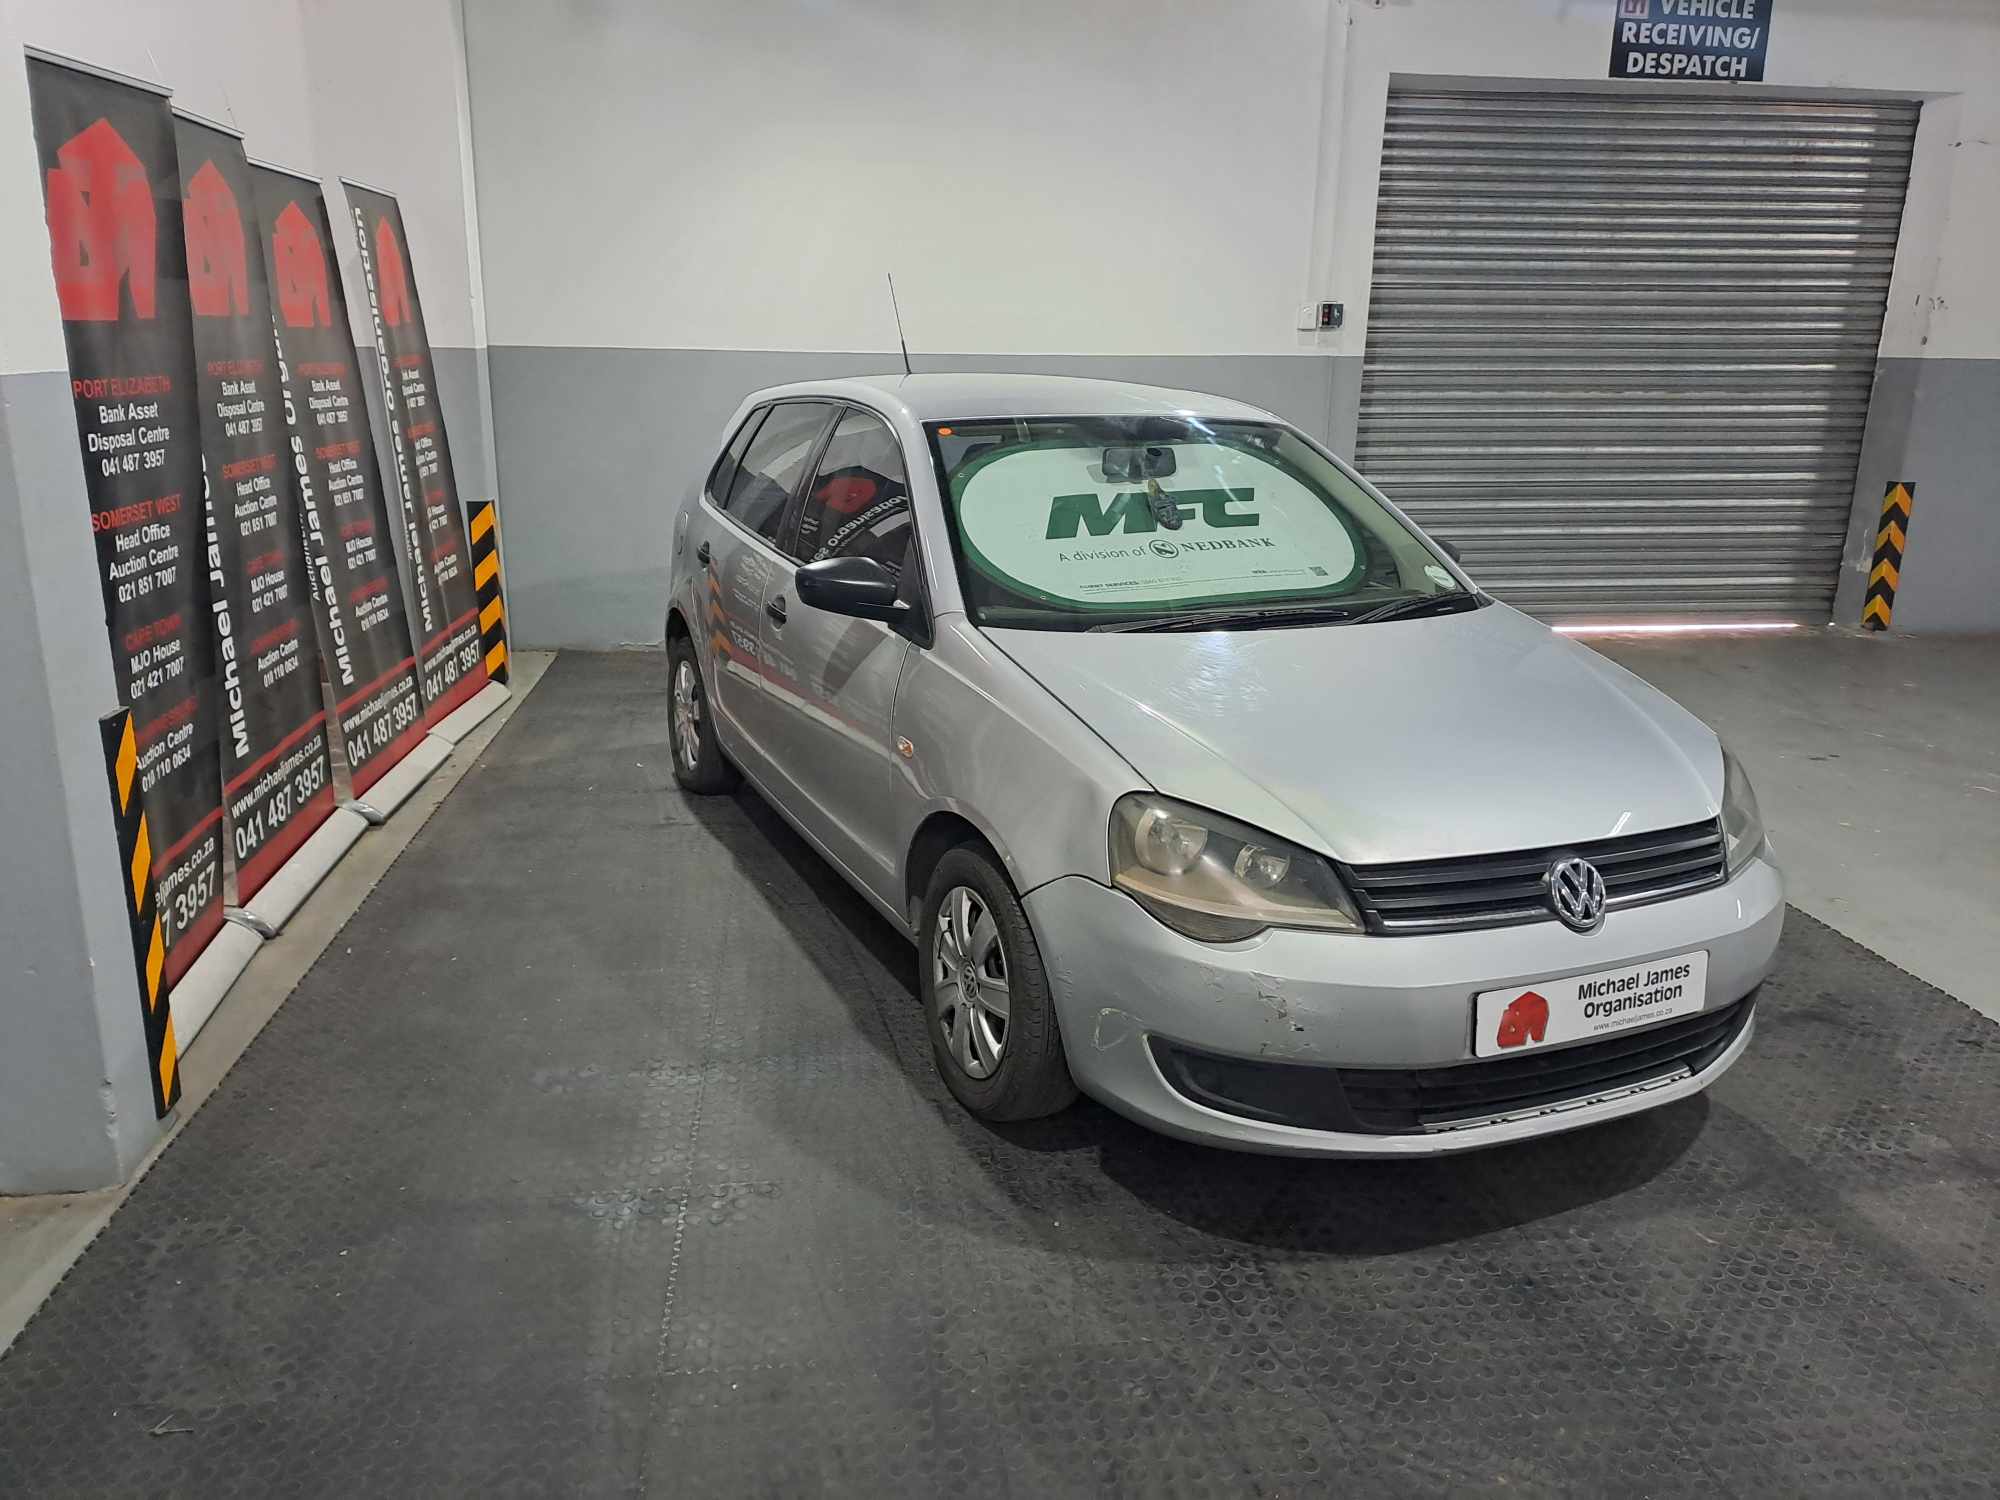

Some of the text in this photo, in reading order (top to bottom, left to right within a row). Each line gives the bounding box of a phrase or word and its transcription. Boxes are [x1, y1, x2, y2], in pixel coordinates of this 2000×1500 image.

[1660, 0, 1755, 19] VEHICLE
[1621, 22, 1760, 49] RECEIVING/
[1626, 52, 1747, 78] DESPATCH
[354, 208, 395, 411] Organisation
[73, 377, 110, 399] PORT
[221, 381, 239, 396] Bank
[99, 402, 159, 424] Bank Asset
[217, 400, 247, 419] Disposal
[88, 426, 170, 452] Disposal Centre
[102, 449, 166, 477] 041 487 3957
[391, 420, 413, 513] James
[90, 500, 153, 532] SOMERSET
[234, 500, 259, 518] Auction
[1045, 487, 1260, 539] MFC
[116, 523, 170, 553] Head Office
[1059, 536, 1277, 563] A division of NEDBANK
[109, 544, 179, 581] Auction Centre
[265, 570, 285, 587] House
[291, 436, 354, 686] Michael James
[408, 522, 433, 632] Michael
[118, 566, 177, 603] 021 851 7007
[130, 639, 181, 675] MJO House
[426, 670, 443, 701] 041
[460, 639, 480, 672] 3957
[130, 656, 185, 699] 021 421 7007
[212, 600, 250, 758] Michael
[343, 675, 413, 734] www.michaeljames.co.za
[167, 721, 194, 749] Centre
[348, 692, 417, 767] 041 487 3957
[231, 735, 322, 818] www.michaeljames.co.za
[236, 755, 324, 859] 041 487 3957
[175, 861, 217, 930] 3957
[1578, 964, 1691, 1000] Michael James
[1584, 984, 1682, 1019] Organisation
[1593, 1007, 1673, 1031] www.michaeljames.co.za
